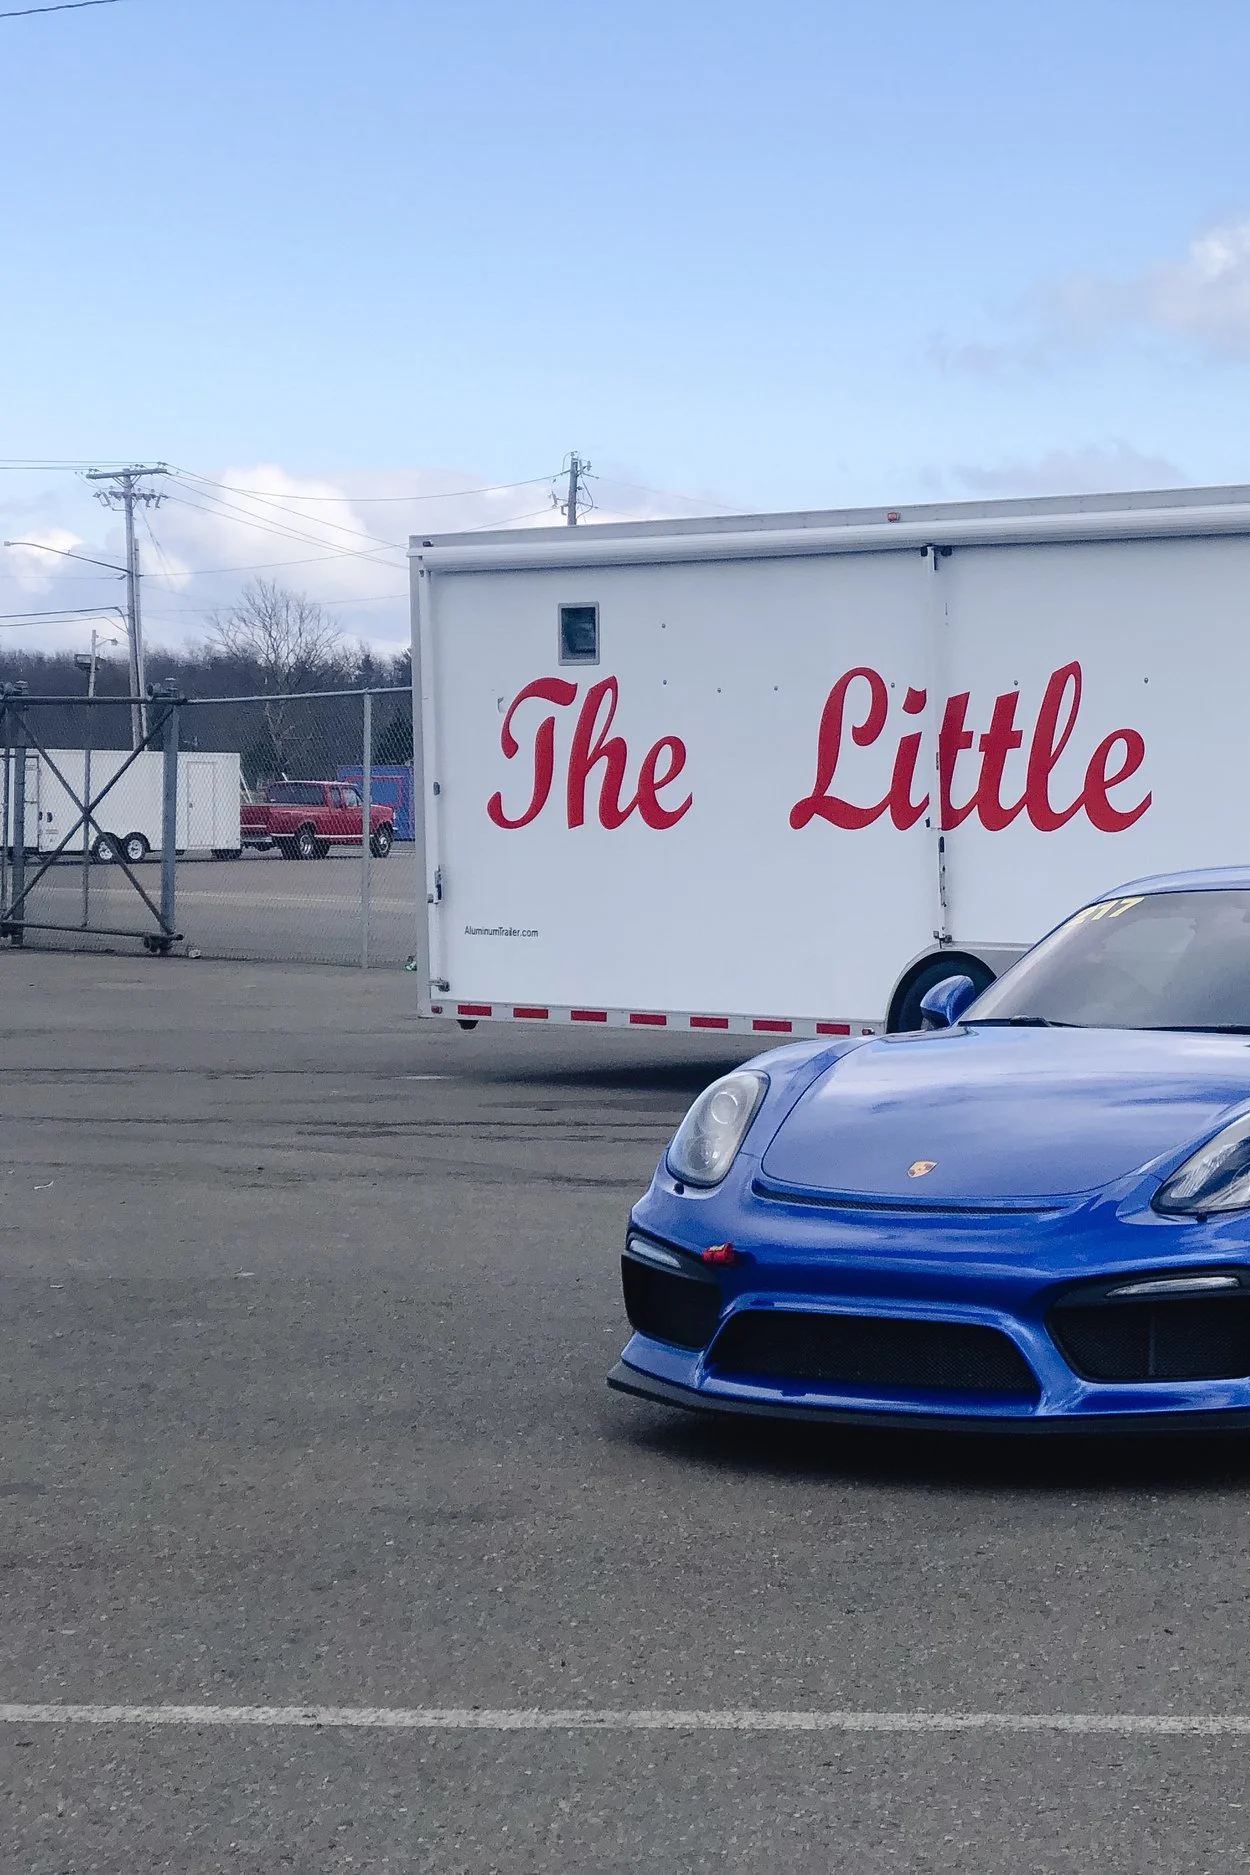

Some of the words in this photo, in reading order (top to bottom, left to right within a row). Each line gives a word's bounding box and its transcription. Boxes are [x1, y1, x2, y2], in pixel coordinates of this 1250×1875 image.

[487, 675, 693, 831] The
[789, 660, 1152, 833] Little
[464, 925, 540, 938] AluminumTrailer.com
